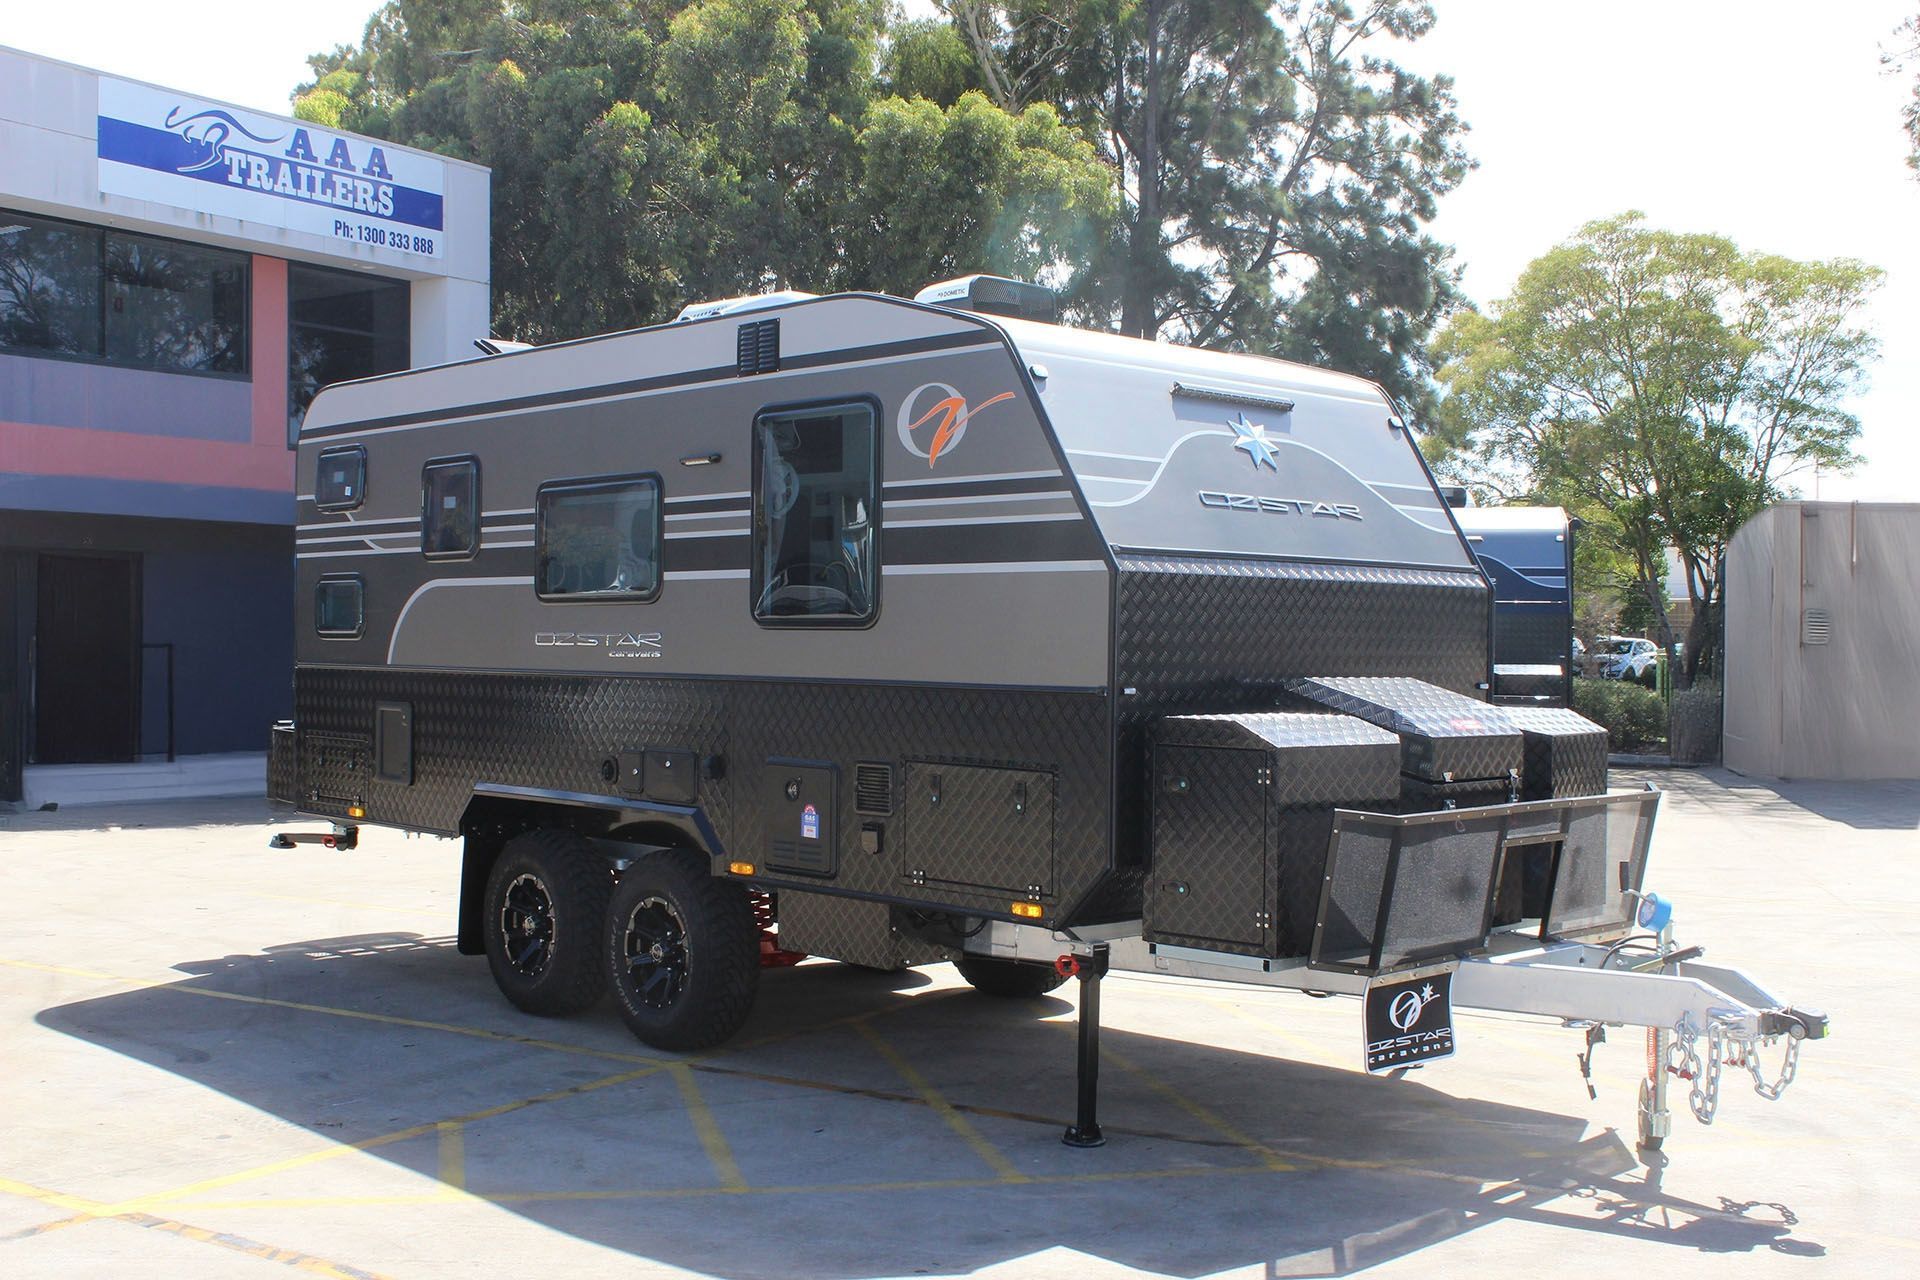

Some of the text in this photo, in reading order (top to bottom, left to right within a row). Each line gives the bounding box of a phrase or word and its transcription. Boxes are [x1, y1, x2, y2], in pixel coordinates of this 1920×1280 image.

[223, 149, 395, 218] TRAILERS
[334, 220, 434, 255] Ph: 1300 333 888
[943, 288, 966, 298] DOMETIC
[1198, 490, 1363, 521] OZSTAR
[535, 632, 662, 648] OZSTAR
[1367, 1027, 1451, 1053] OZSTAR
[1368, 1041, 1452, 1064] caravans
